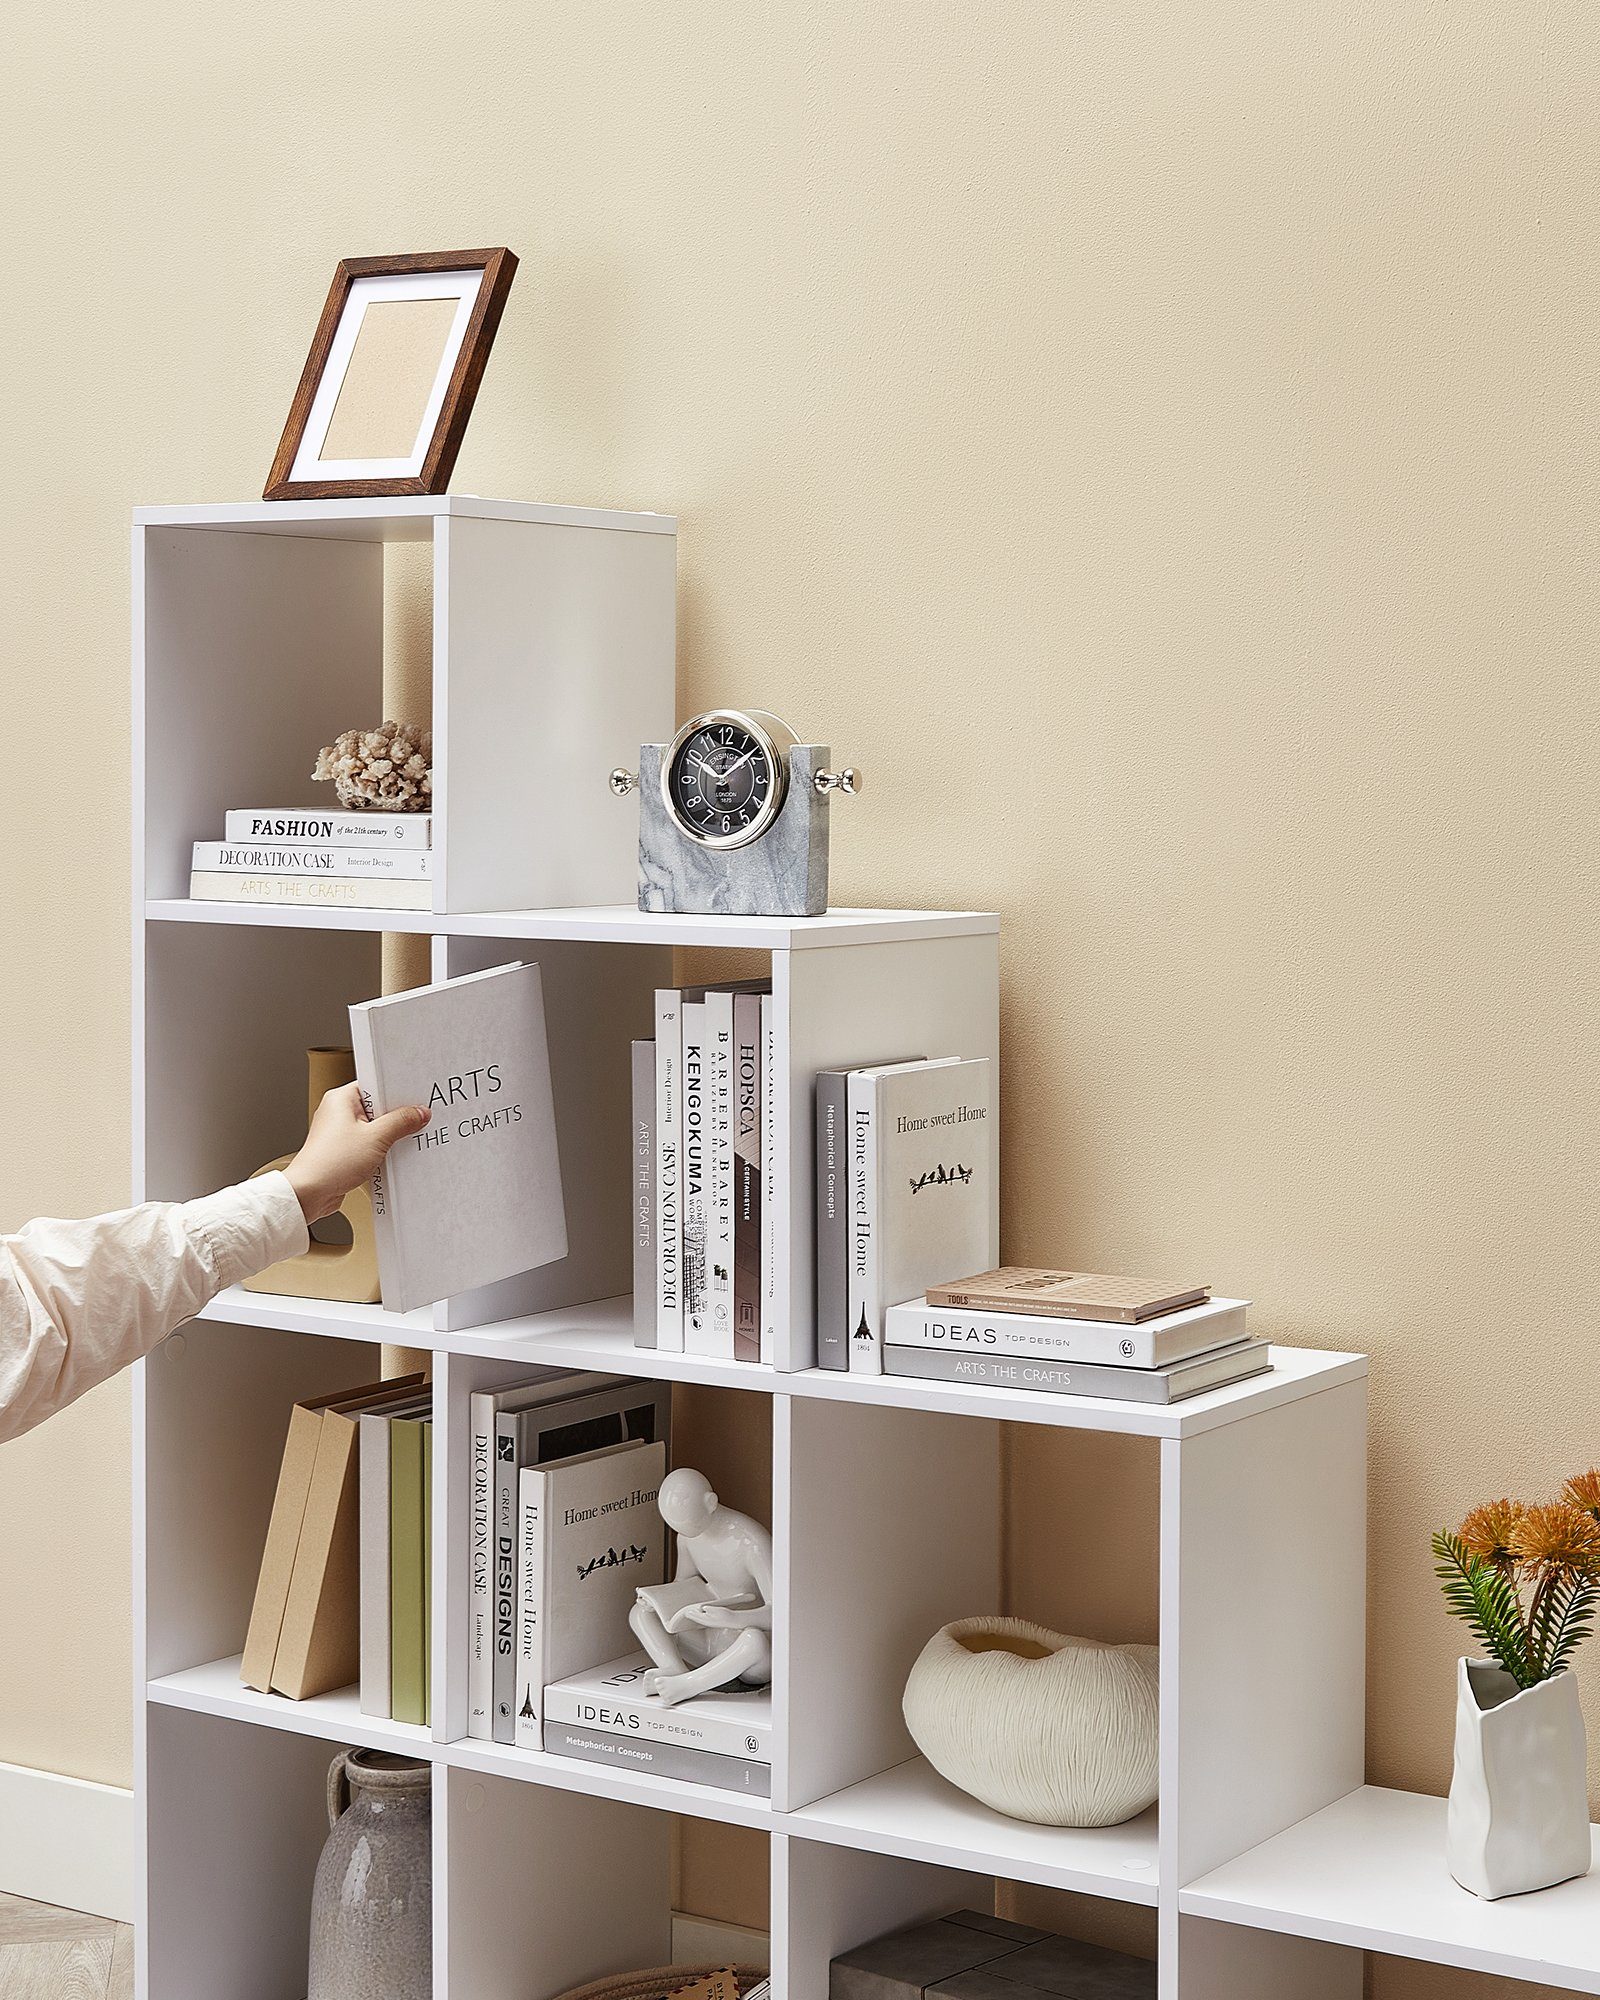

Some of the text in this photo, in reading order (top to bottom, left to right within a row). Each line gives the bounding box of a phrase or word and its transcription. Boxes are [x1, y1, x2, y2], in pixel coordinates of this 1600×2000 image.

[700, 732, 716, 752] 11
[718, 727, 734, 745] 12
[740, 734, 750, 749] 1
[686, 750, 702, 768] 10
[682, 775, 697, 784] 9
[756, 776, 768, 784] 3
[686, 796, 702, 808] 8
[752, 796, 764, 808] 4
[251, 820, 333, 838] FASHION
[337, 826, 344, 835] of
[366, 828, 387, 837] century
[701, 809, 715, 824] 7
[722, 814, 730, 832] 6
[740, 809, 750, 826] 5
[219, 850, 394, 869] DECORATION CASE Interior Design
[241, 881, 357, 899] ARTS THE CRAFTS
[428, 1064, 502, 1109] ARTS
[740, 1044, 755, 1136] HOPSCA
[412, 1104, 522, 1151] THE CRAFTS
[896, 1106, 986, 1134] Home sweet Home
[718, 1031, 729, 1242] BARBERA BAREY
[662, 1142, 676, 1186] CASE
[826, 1104, 836, 1219] Metaphorical Concepts
[639, 1120, 650, 1247] ARTS THE CRAFTS
[856, 1110, 870, 1276] Home sweet Home
[663, 1190, 676, 1309] DECORATION
[948, 1294, 968, 1305] TOOLS
[924, 1322, 1070, 1347] IDEAS TOP DESIGN
[955, 1360, 1071, 1386] ARTS THE CRAFTS
[564, 1508, 598, 1526] Home
[601, 1496, 628, 1516] sweet
[474, 1434, 488, 1661] DECORATION CASE Landscape
[499, 1487, 513, 1656] GREAT DESIGNS
[523, 1505, 538, 1660] Home sweet Home
[577, 1704, 703, 1738] IDEAS TOP DESIGN
[566, 1736, 653, 1761] Metaphorical Concepts
[716, 1982, 724, 1993] BY
